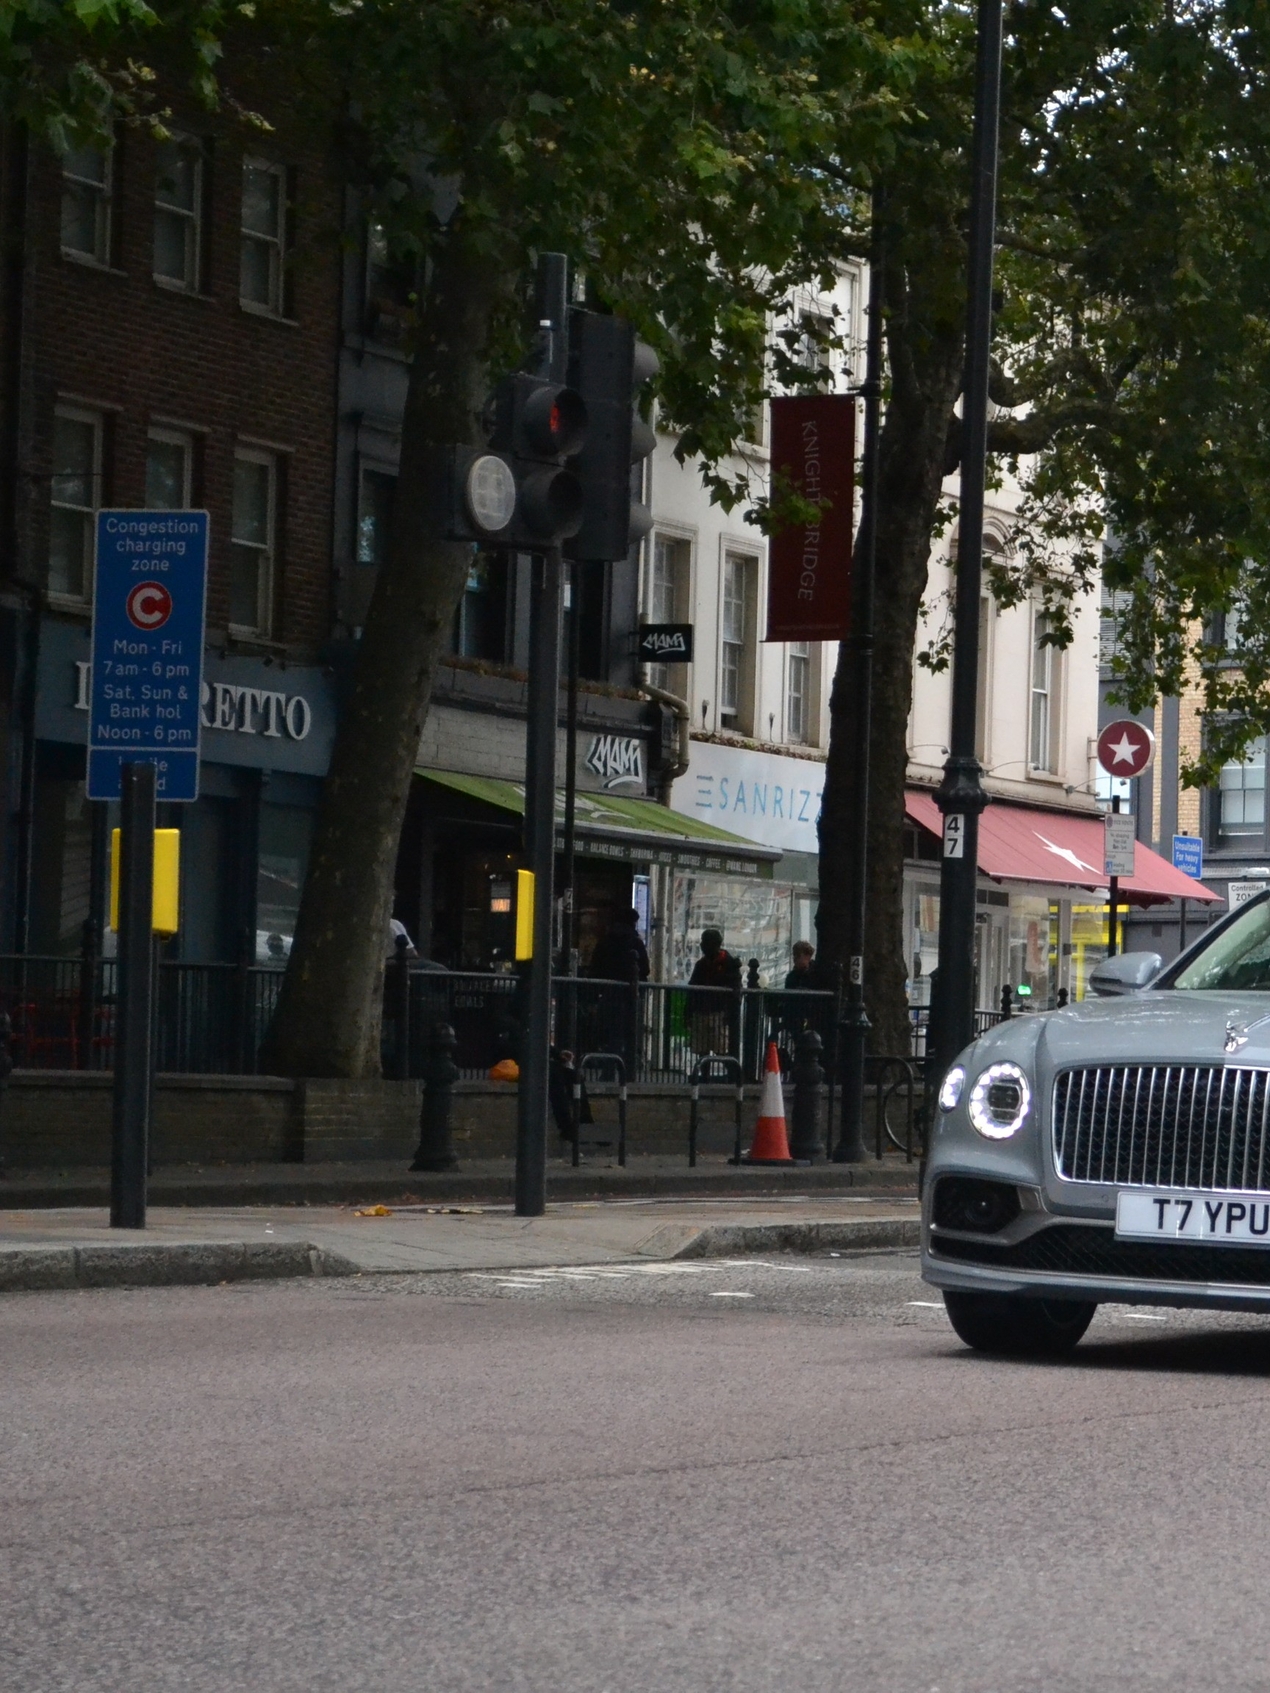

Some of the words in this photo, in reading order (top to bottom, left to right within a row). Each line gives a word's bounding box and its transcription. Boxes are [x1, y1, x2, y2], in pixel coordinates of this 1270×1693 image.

[797, 420, 821, 602] KNIGHTBRIDGE
[106, 518, 199, 538] Congestion
[116, 538, 186, 555] charging
[131, 558, 170, 571] zone
[113, 639, 148, 655] Mon
[161, 640, 182, 655] Fri
[141, 684, 172, 700] Sun
[177, 685, 189, 700] &
[110, 703, 151, 718] Bank
[156, 703, 182, 719] hol
[97, 724, 141, 739] Noon
[1174, 841, 1200, 852] Unsuitable
[1185, 852, 1199, 864] heavy
[1231, 884, 1264, 892] Controlled
[1152, 1198, 1193, 1231] T7
[1204, 1201, 1270, 1236] YPU
